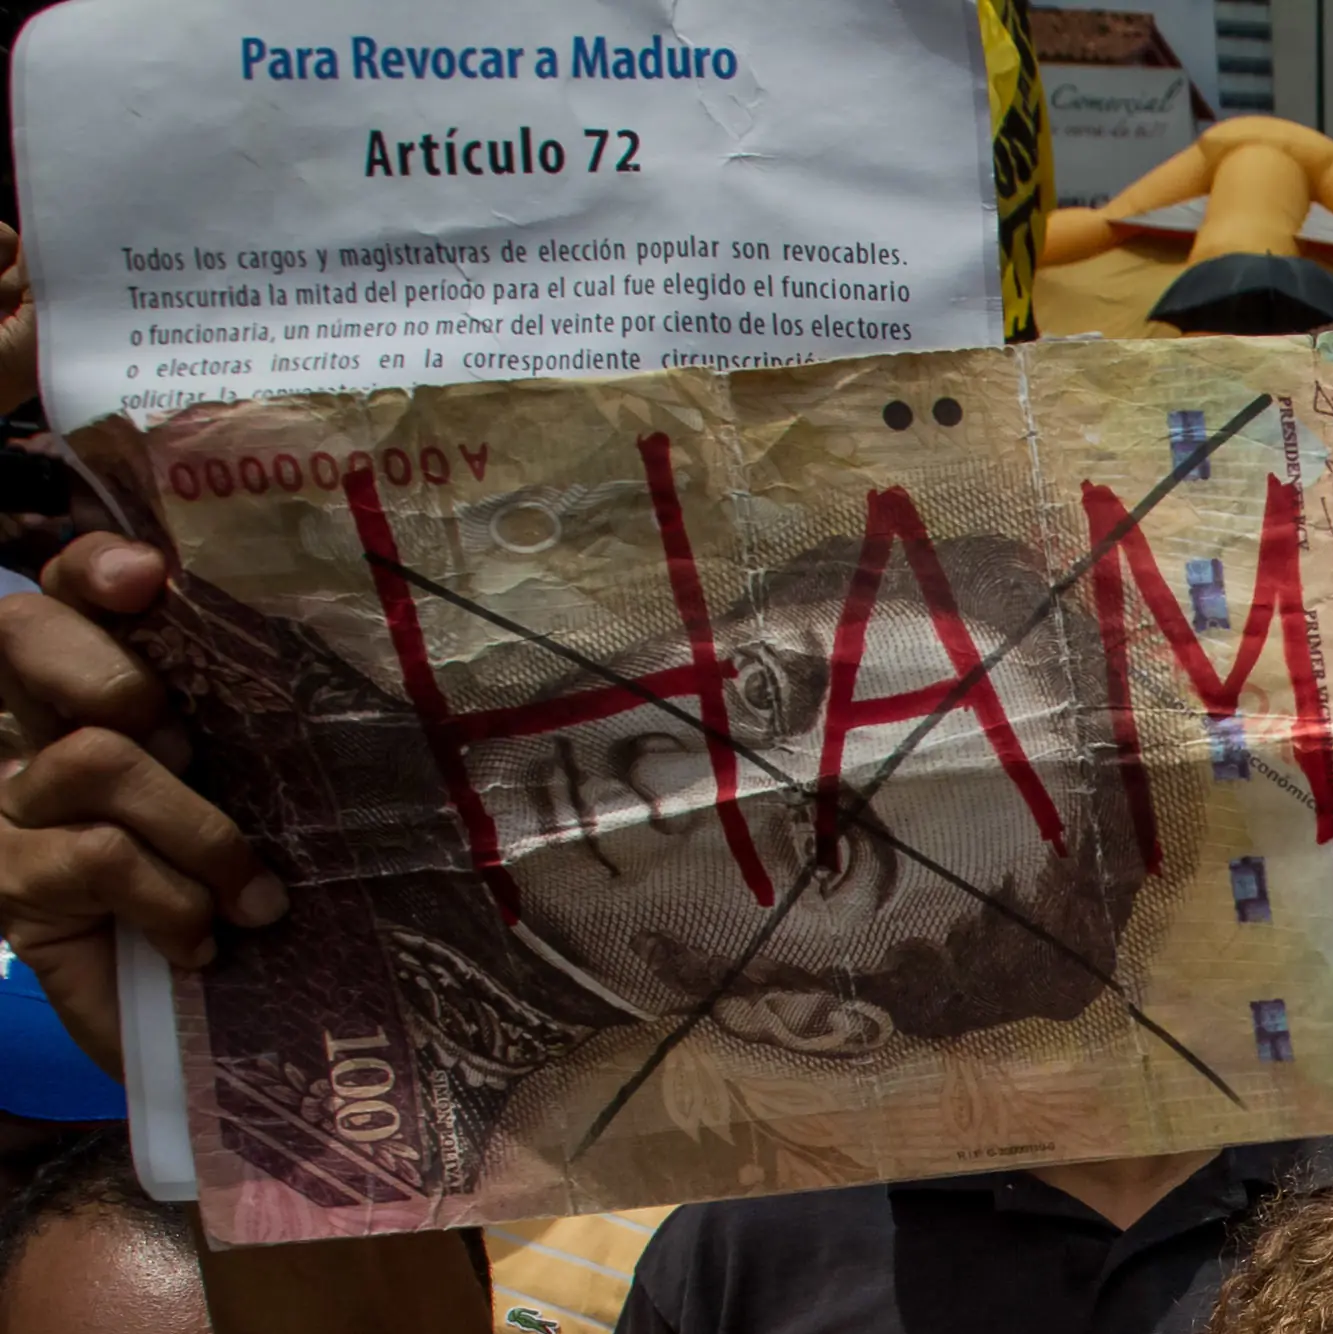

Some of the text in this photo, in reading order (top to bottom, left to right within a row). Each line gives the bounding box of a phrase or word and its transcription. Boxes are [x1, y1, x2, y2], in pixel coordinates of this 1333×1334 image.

[242, 35, 738, 81] Para Revocar a Maduro
[364, 127, 643, 178] Artículo 72
[122, 235, 908, 275] Todos los cargos y magistraturas de elección popular son revocables.
[128, 272, 910, 311] Transcurrida la mitad del período para el cual fue elegido el funcionario
[130, 311, 912, 347] o funcionaria, un número no menor del veinte por ciento de los electores
[127, 363, 139, 379] o
[156, 356, 252, 379] electoras
[270, 350, 360, 373] inscritos
[379, 352, 405, 370] en
[425, 349, 443, 369] la
[463, 348, 641, 377] correspondiente
[324, 1025, 401, 1142] 100
